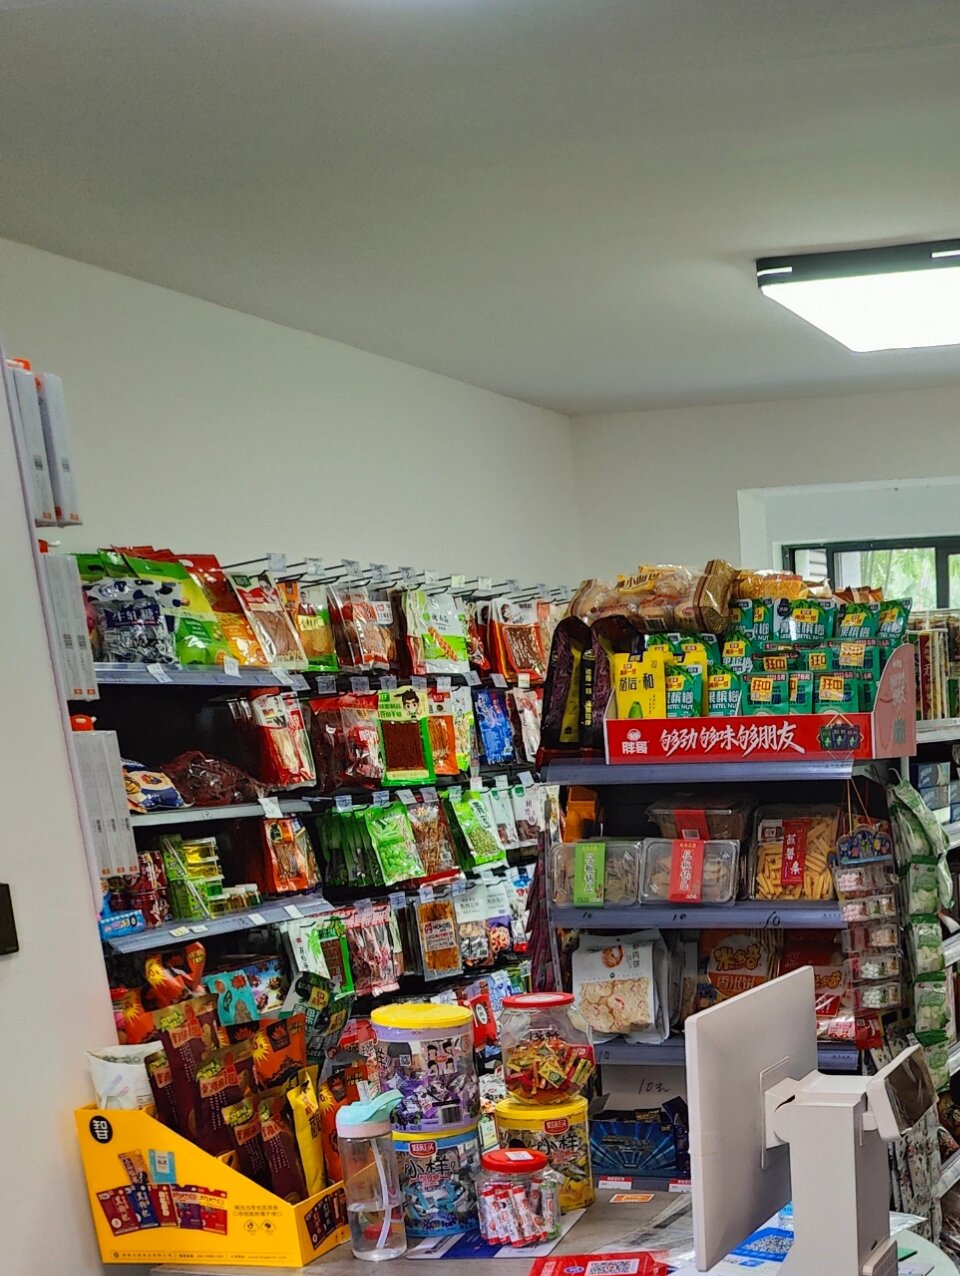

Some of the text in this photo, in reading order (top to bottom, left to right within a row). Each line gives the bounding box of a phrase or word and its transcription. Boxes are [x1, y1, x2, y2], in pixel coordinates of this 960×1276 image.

[622, 740, 648, 755] 胖哥
[660, 720, 806, 757] 够劲够味够朋友
[766, 911, 781, 928] 10
[409, 1157, 451, 1179] 小样
